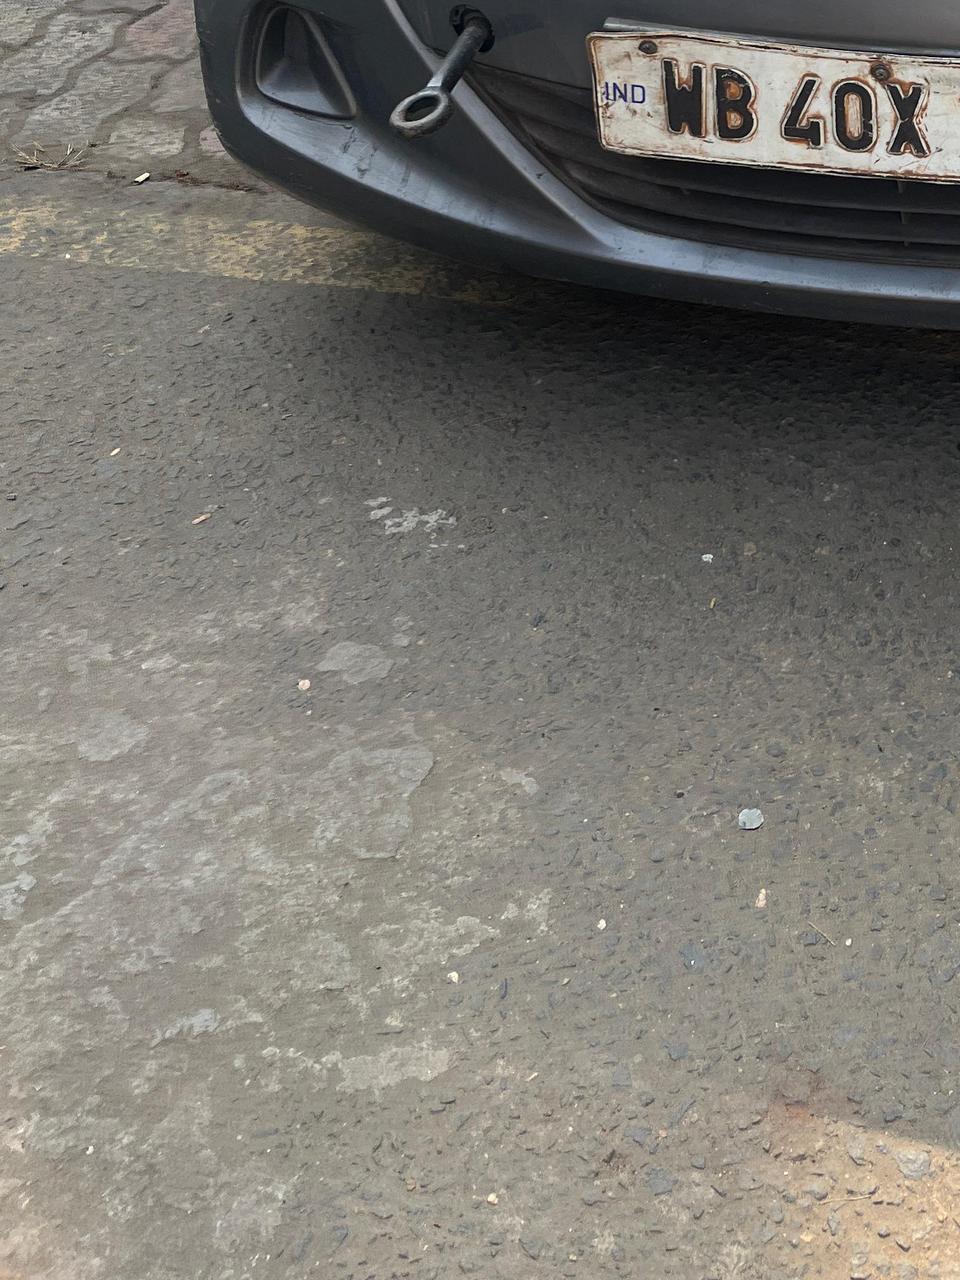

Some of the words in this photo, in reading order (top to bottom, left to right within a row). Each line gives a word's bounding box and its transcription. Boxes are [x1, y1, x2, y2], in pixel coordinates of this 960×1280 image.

[604, 81, 645, 104] IND
[662, 58, 759, 141] WB
[781, 76, 931, 158] 40X
